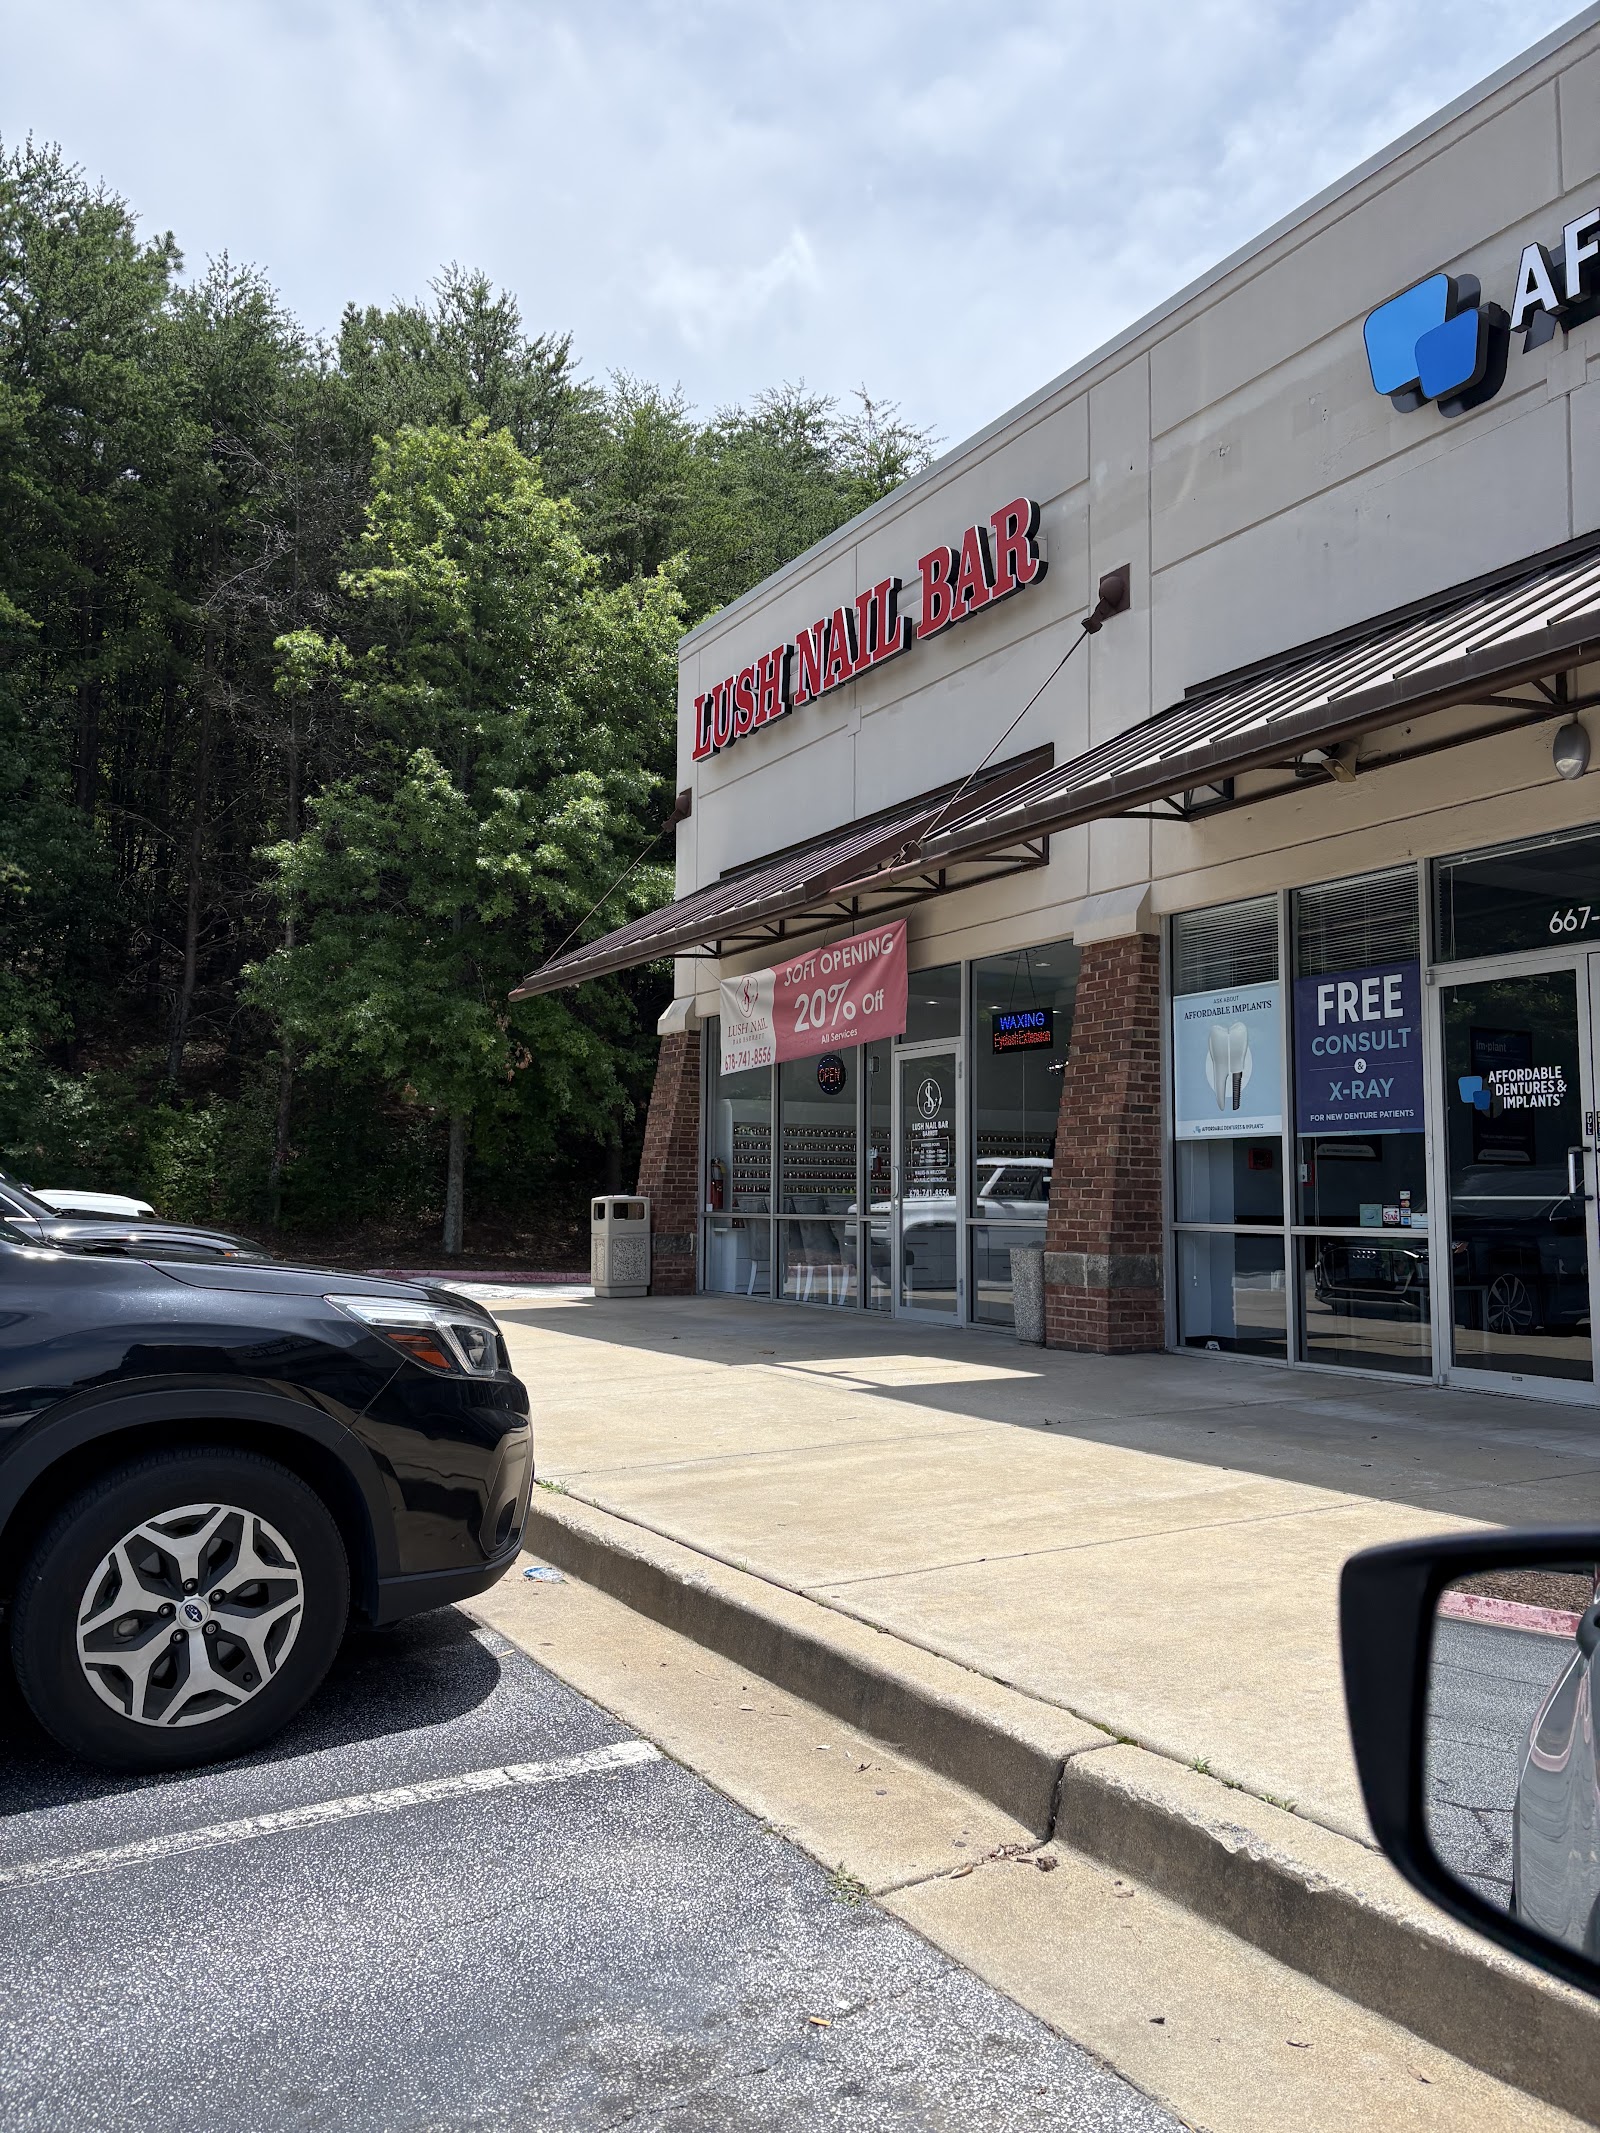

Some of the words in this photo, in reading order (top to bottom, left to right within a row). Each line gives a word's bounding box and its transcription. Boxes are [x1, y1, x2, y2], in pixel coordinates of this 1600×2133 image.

[691, 643, 793, 762] LUSH
[794, 576, 911, 706] NAIL
[917, 497, 1048, 640] BAR
[783, 958, 815, 987] SOFT
[820, 932, 894, 974] OPENING
[794, 979, 856, 1033] 20%
[862, 989, 884, 1015] Off
[1223, 995, 1239, 1003] ABOUT
[1317, 973, 1404, 1026] FREE
[1184, 1006, 1230, 1020] AFFORDABLE
[1232, 1000, 1272, 1013] IMPLANTS
[728, 1022, 748, 1037] LUSH
[750, 1017, 768, 1033] NAIL
[1000, 1012, 1044, 1030] WAXING
[821, 1033, 829, 1044] All
[830, 1028, 857, 1042] Services
[1311, 1027, 1411, 1056] CONSULT
[725, 1046, 771, 1071] 678-741-8556
[1357, 1061, 1364, 1070] &
[818, 1067, 841, 1083] OPEN
[1488, 1066, 1562, 1083] AFFORDABLE
[1329, 1077, 1394, 1101] X-RAY
[1495, 1080, 1554, 1096] DENTURES
[1557, 1079, 1567, 1093] &
[1310, 1114, 1325, 1122] FOR
[1326, 1113, 1342, 1121] NEW
[1344, 1111, 1378, 1120] DENTURE
[1379, 1109, 1414, 1119] PATIENTS
[912, 1122, 924, 1131] LUSH
[925, 1121, 937, 1129] NAIL
[938, 1120, 949, 1129] BAR
